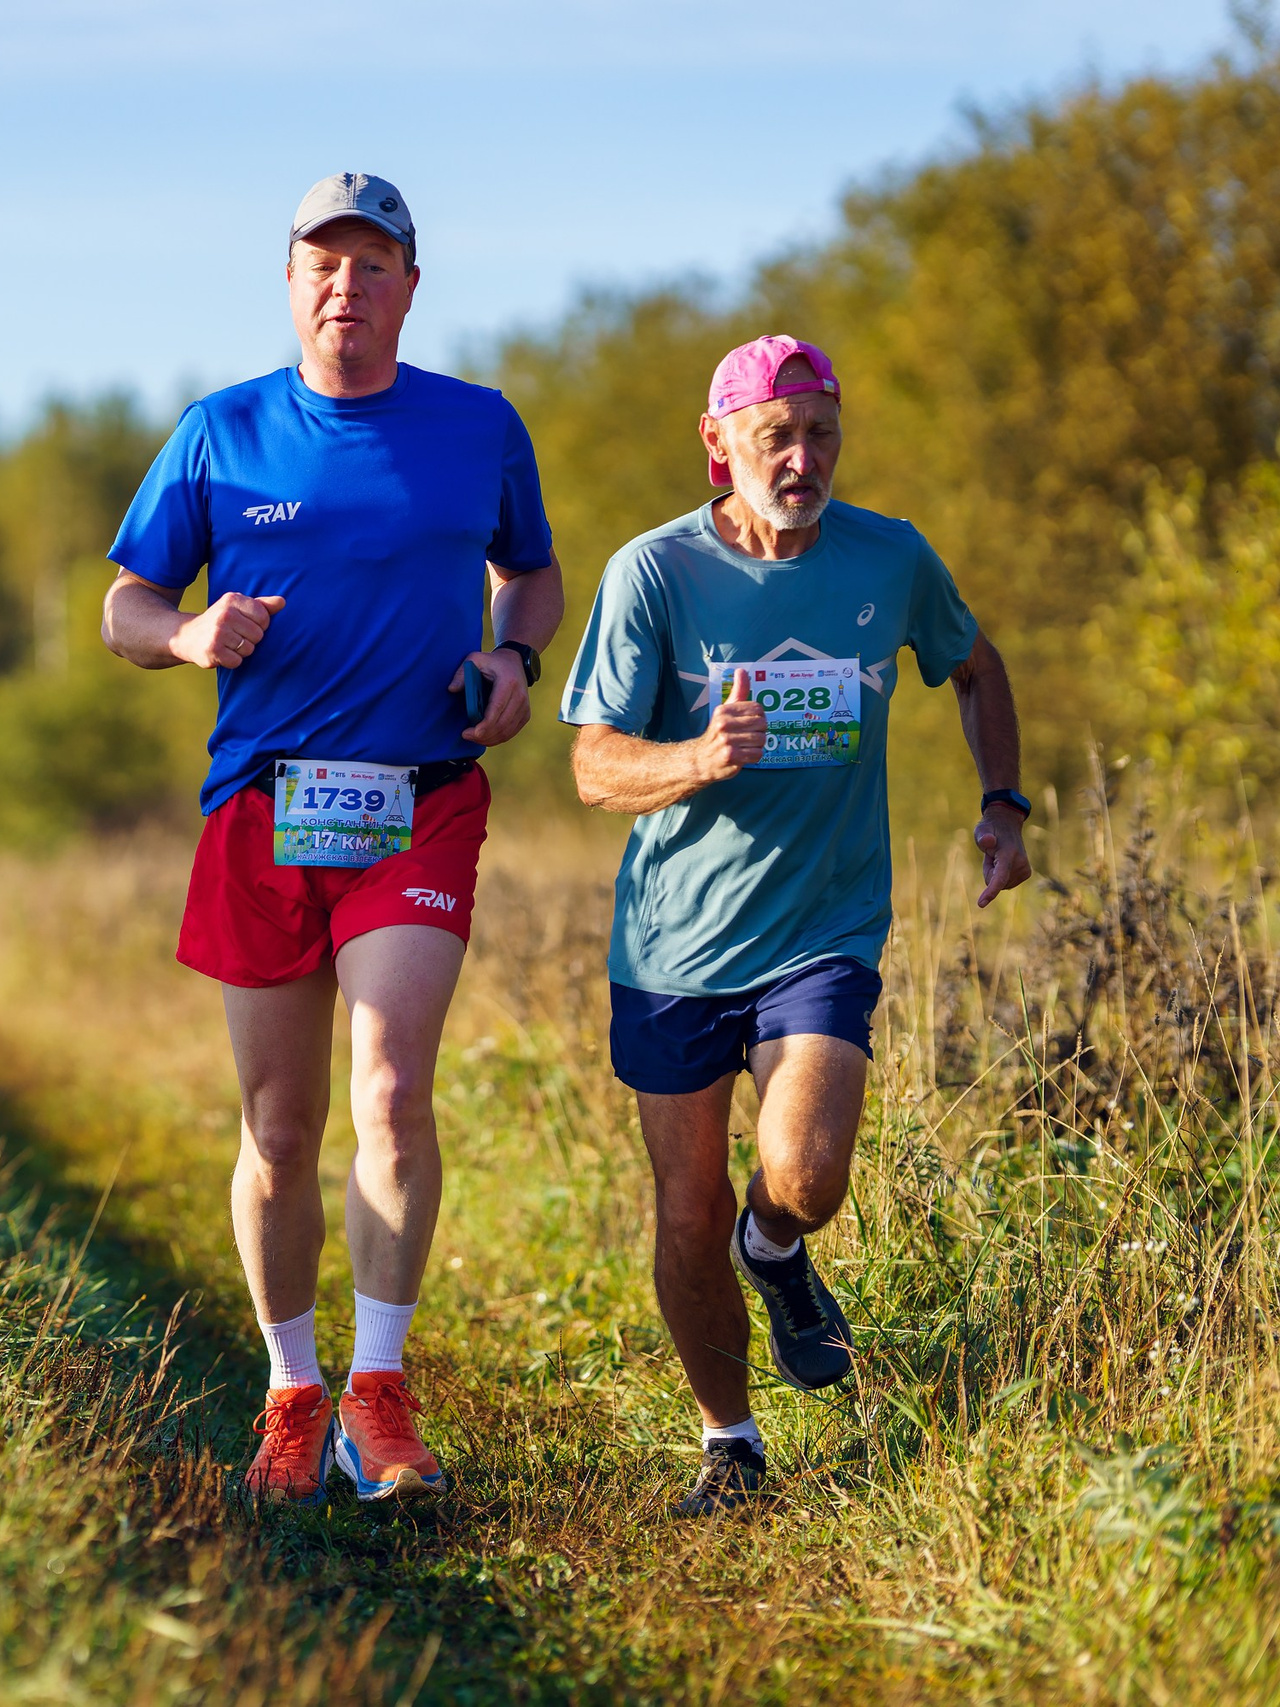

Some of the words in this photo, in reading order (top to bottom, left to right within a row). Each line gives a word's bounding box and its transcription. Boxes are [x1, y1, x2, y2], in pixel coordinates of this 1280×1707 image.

[243, 502, 301, 525] RAY
[764, 734, 778, 751] 0
[303, 786, 386, 812] 1739
[301, 818, 385, 829] КОНСТАНТИН
[312, 830, 335, 849] 17
[401, 888, 456, 912] RAY
